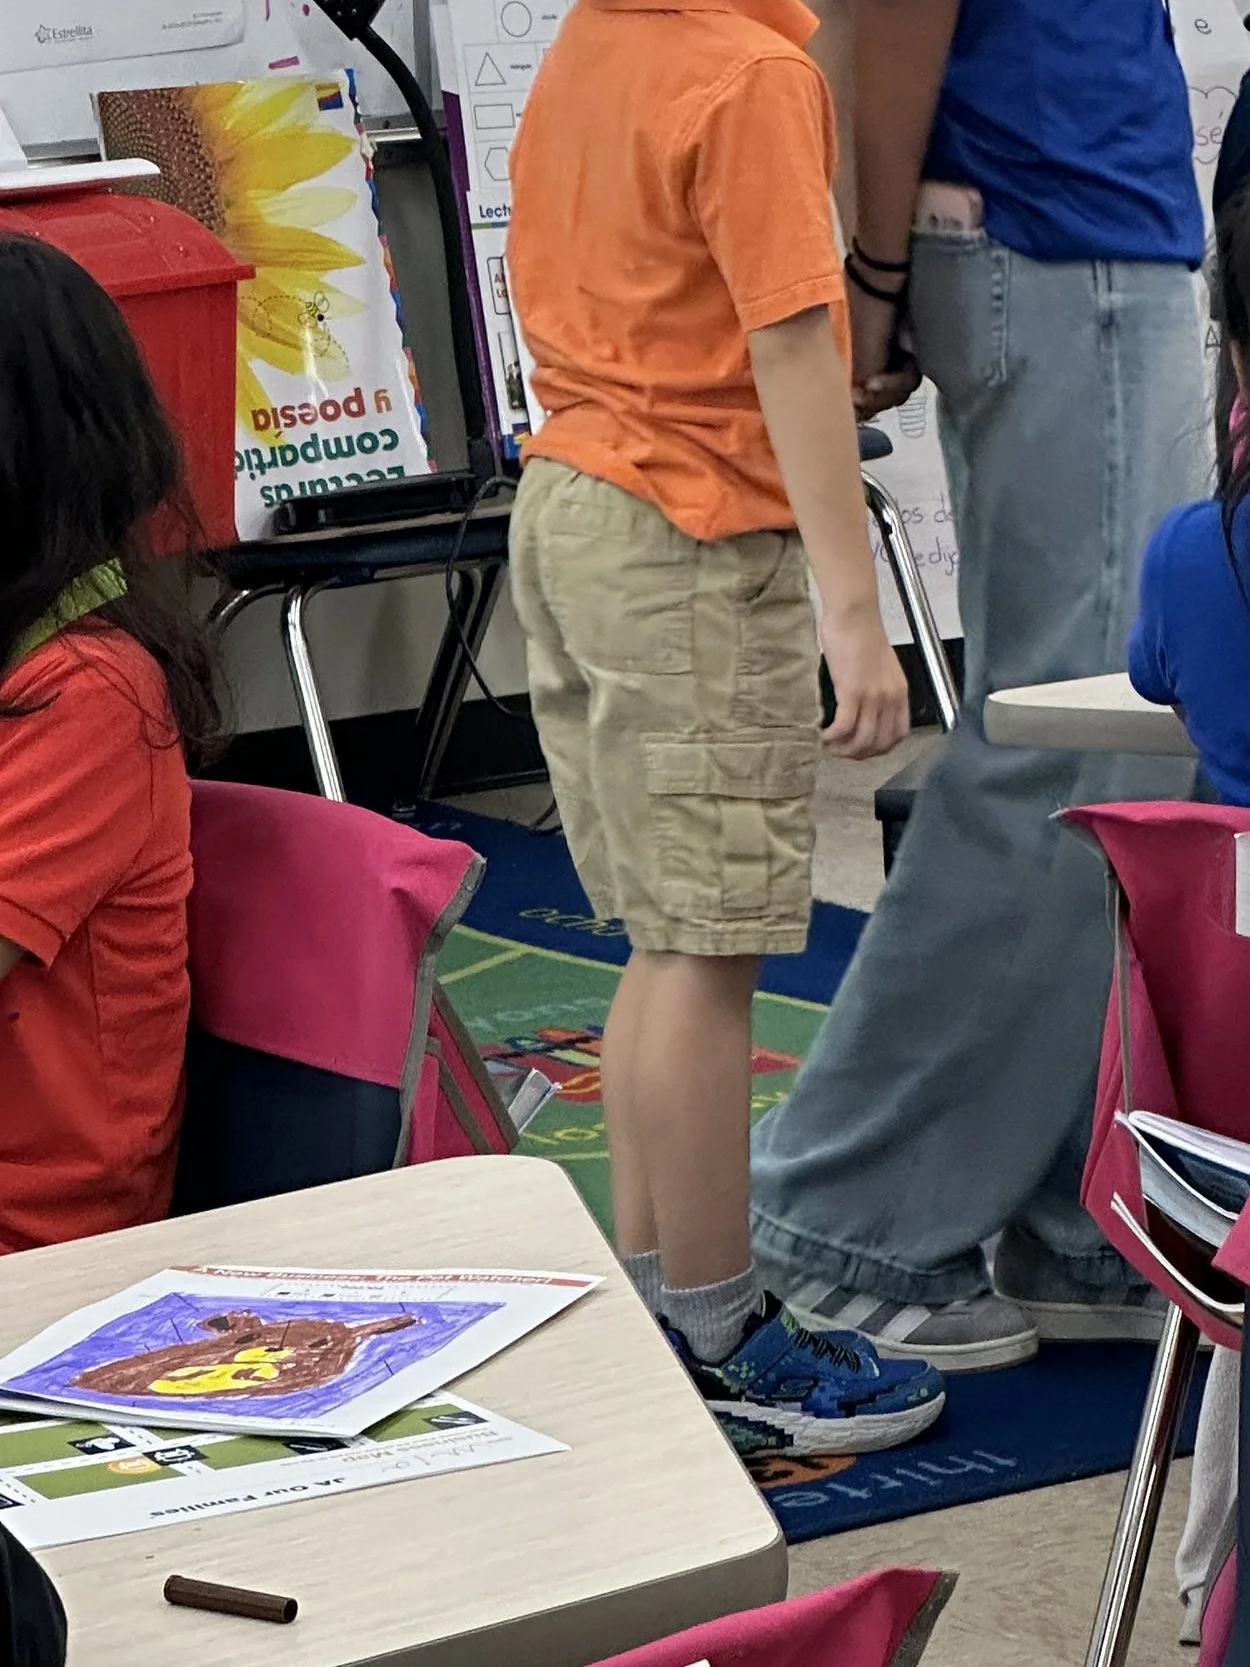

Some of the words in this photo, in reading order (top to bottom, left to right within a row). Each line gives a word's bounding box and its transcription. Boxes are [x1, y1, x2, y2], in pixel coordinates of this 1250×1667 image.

[251, 387, 366, 438] poesía
[373, 388, 393, 414] y
[263, 1484, 308, 1498] Our
[312, 1476, 346, 1488] JA
[149, 1493, 257, 1518] Families
